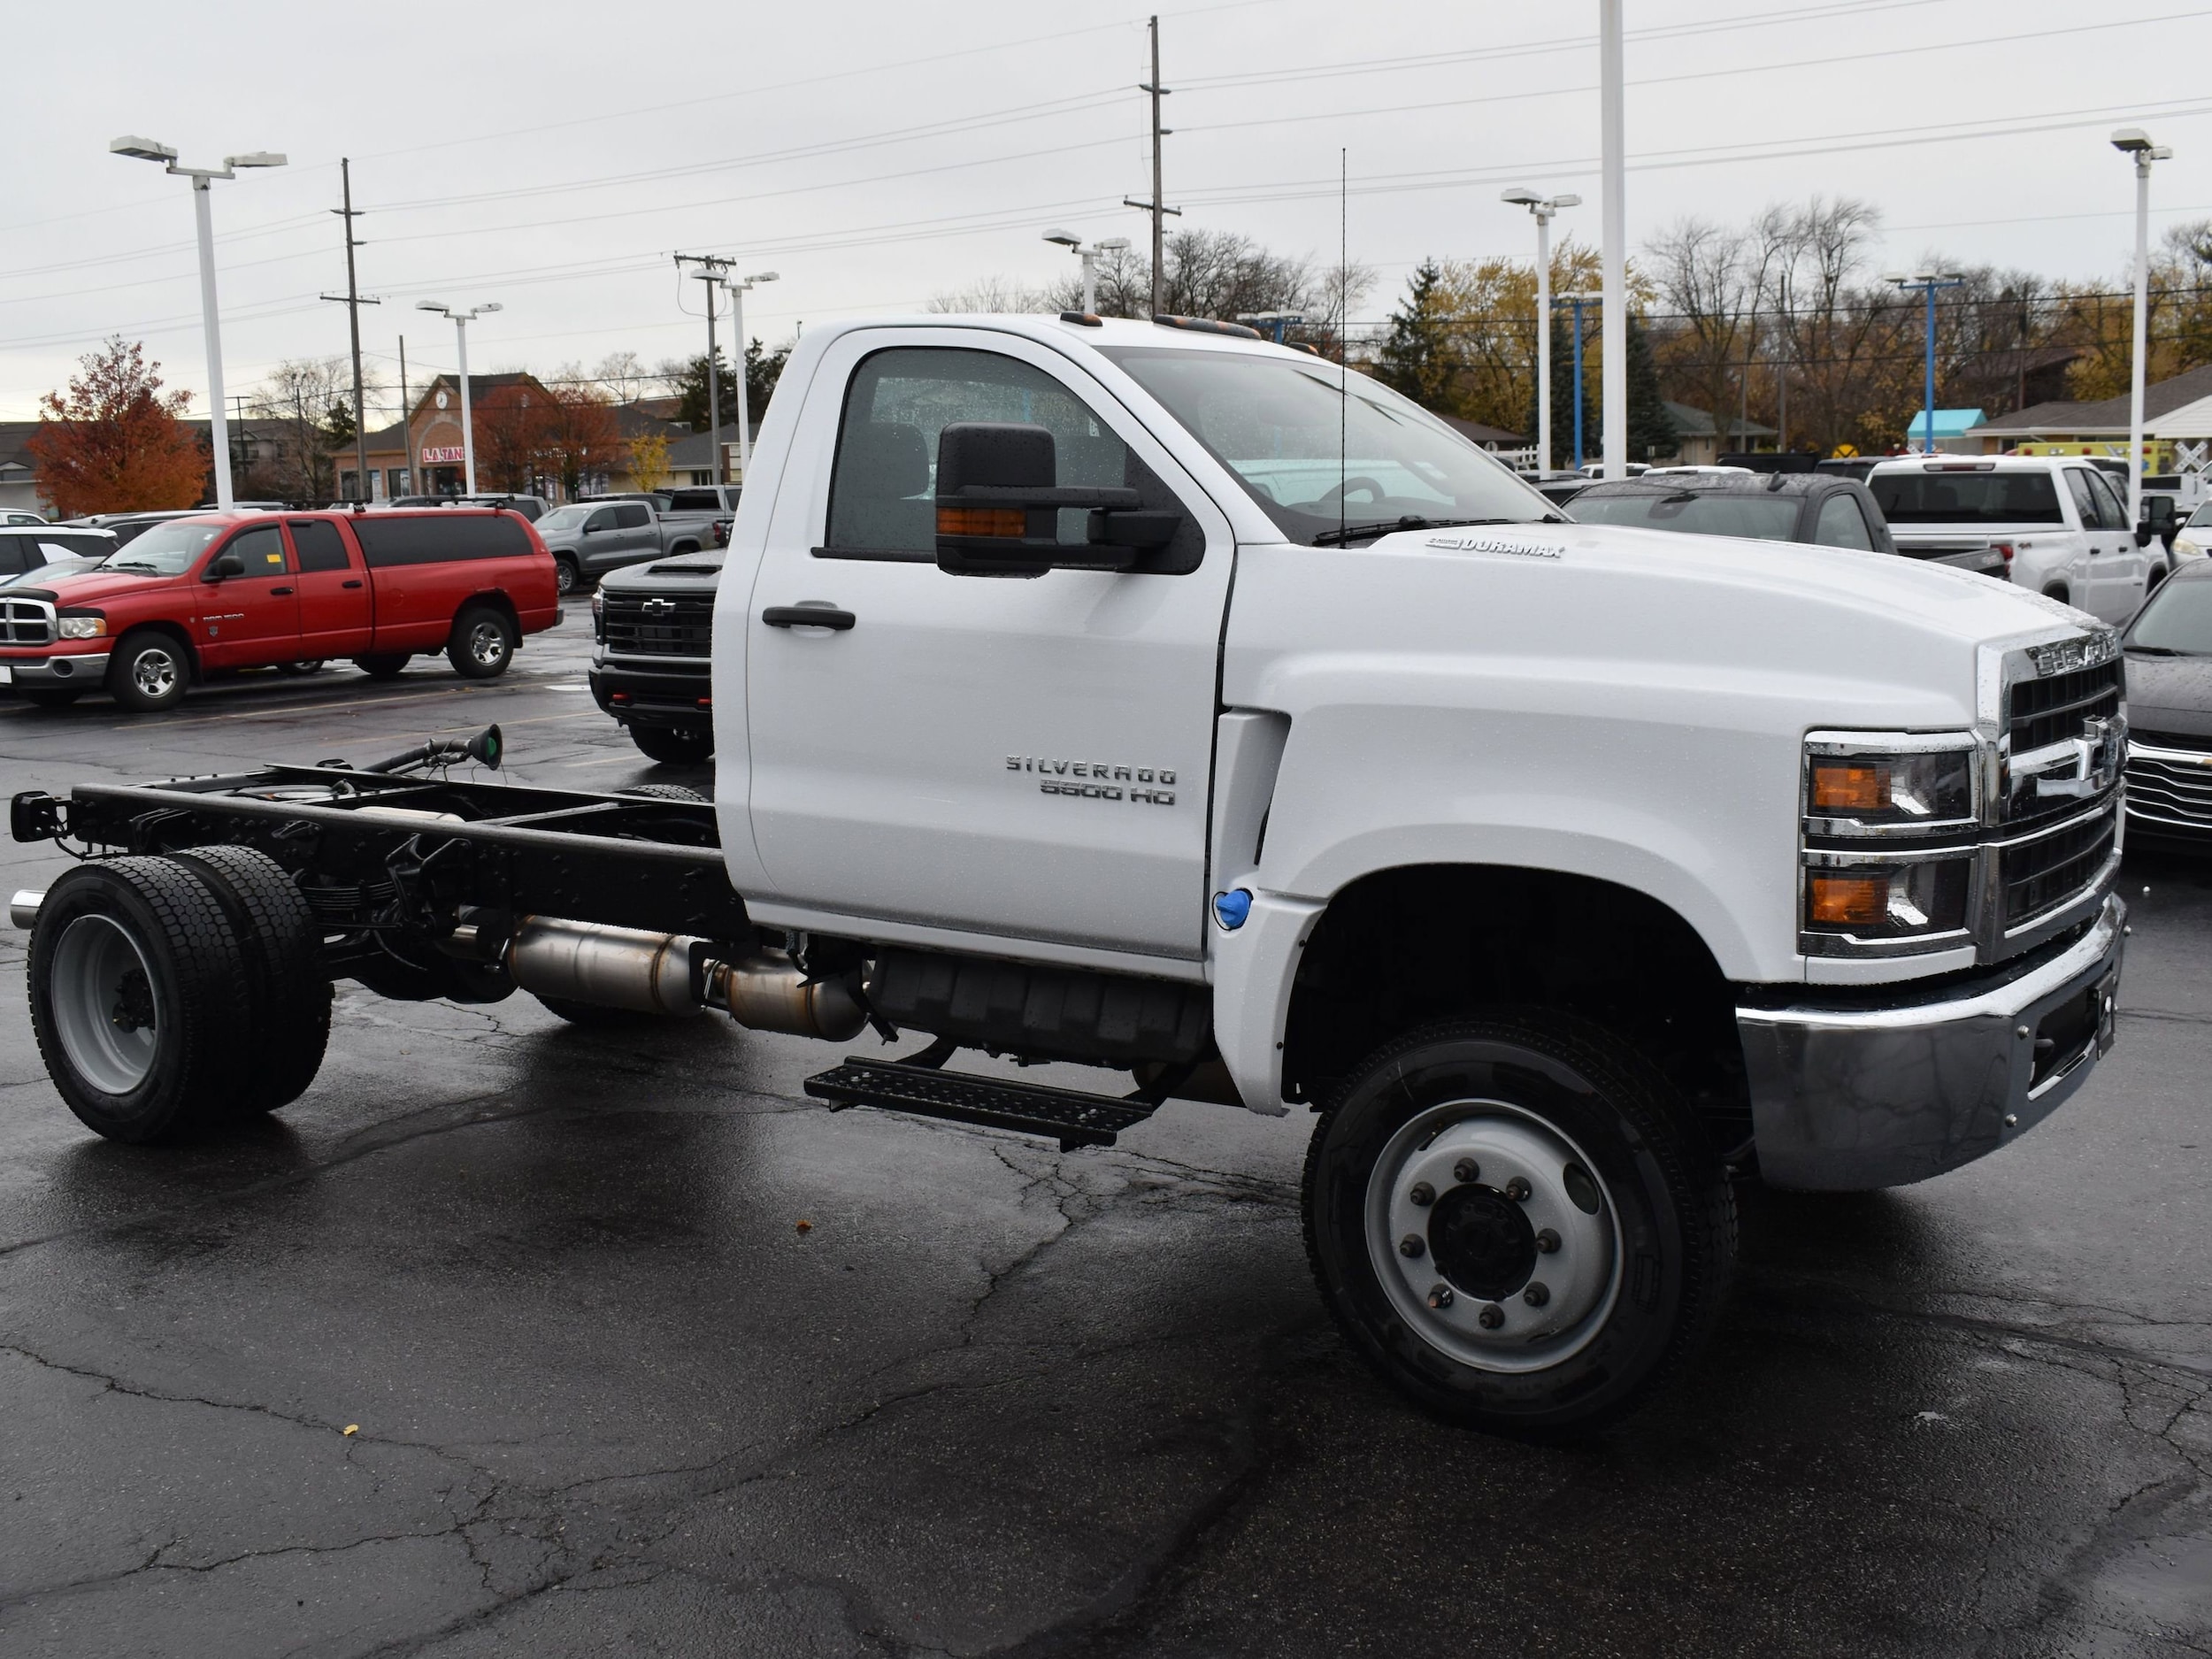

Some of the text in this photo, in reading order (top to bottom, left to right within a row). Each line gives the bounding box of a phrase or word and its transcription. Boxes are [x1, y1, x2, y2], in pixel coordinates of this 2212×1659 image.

[442, 447, 465, 461] TAN
[1460, 538, 1565, 558] DURAMAX
[1006, 755, 1177, 785] SILVERADO
[1040, 779, 1176, 806] 5500 HD
